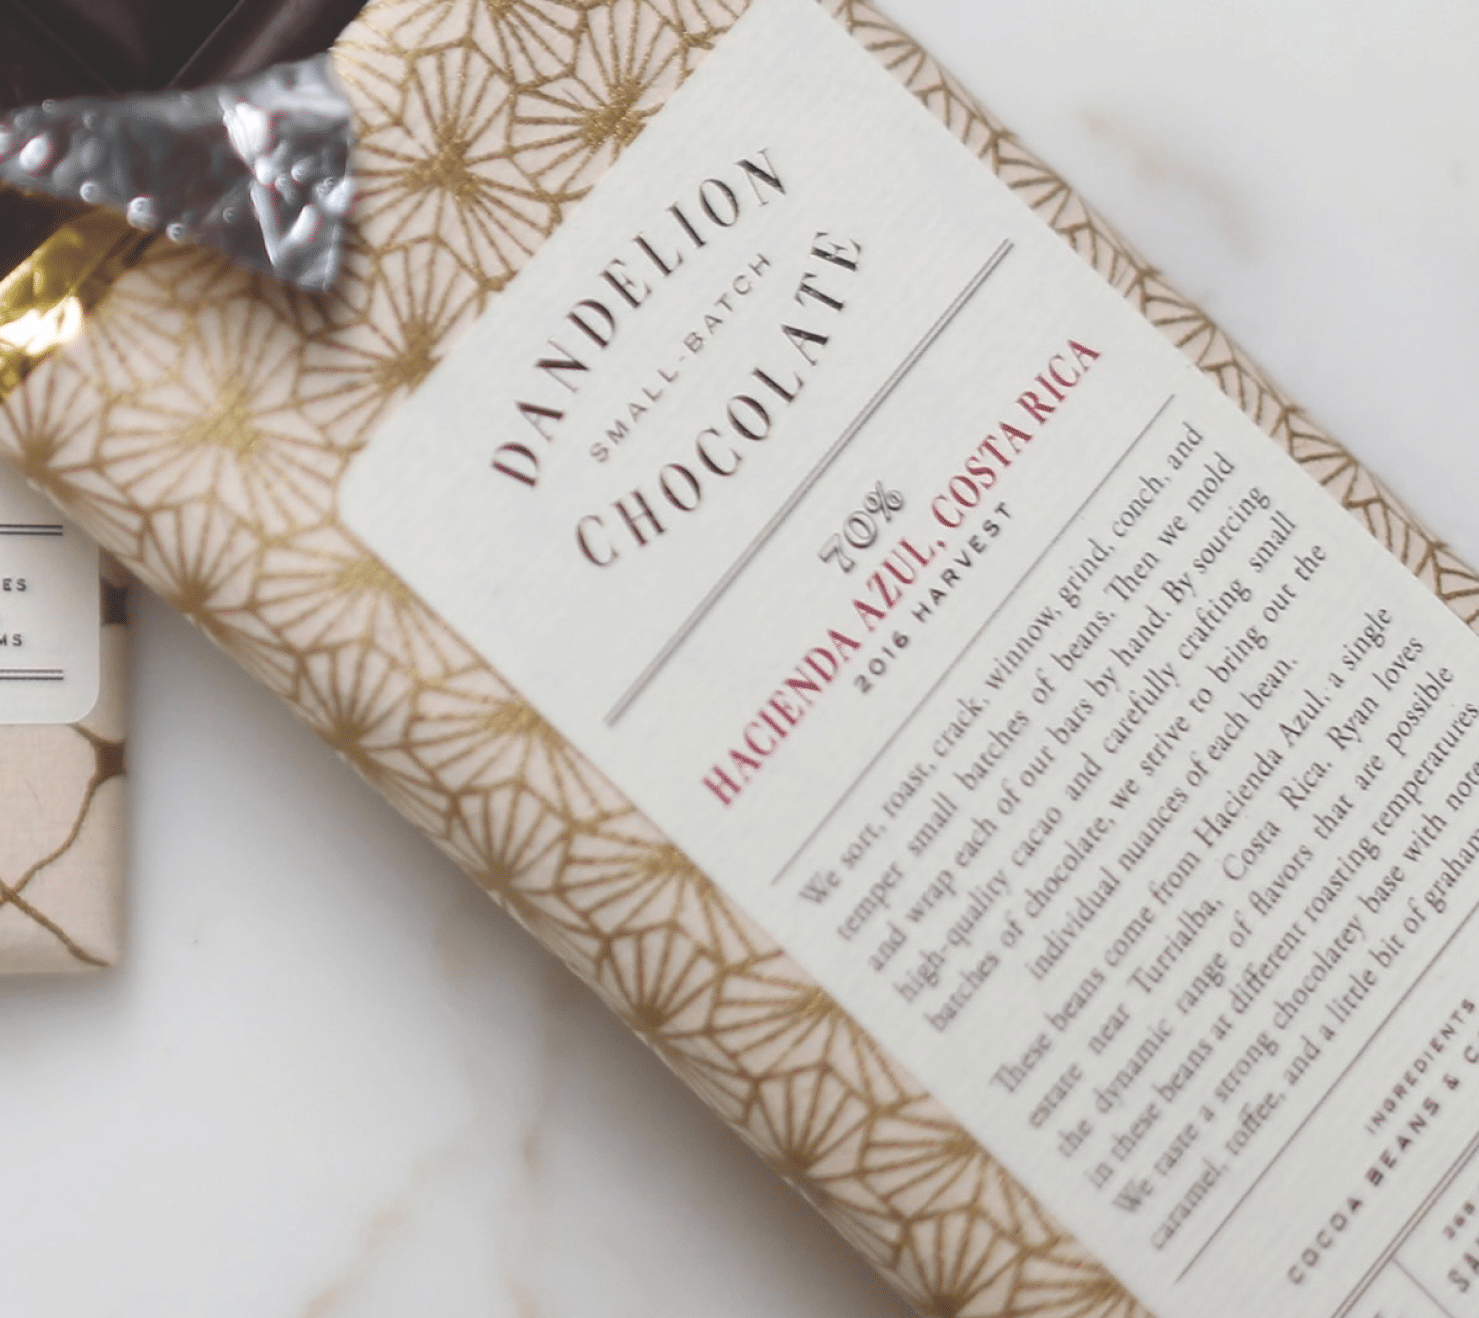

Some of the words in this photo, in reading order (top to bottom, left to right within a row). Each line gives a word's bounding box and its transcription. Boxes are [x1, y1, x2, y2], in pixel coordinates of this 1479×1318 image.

[490, 147, 787, 488] DANDELION
[574, 229, 864, 569] CHOCOLATE
[588, 251, 772, 465] SMALL-BATCH
[702, 628, 862, 806] HACIENDA
[852, 538, 947, 632] AZUL,
[931, 421, 1034, 529] COSTA
[1015, 339, 1101, 425] RICA
[817, 480, 905, 575] 70%
[853, 630, 910, 694] 2016
[911, 500, 1011, 623] HARVEST
[984, 605, 1063, 690] winnow,
[1058, 537, 1115, 610] grind,
[1112, 475, 1171, 538] conch,
[1166, 420, 1204, 471] and
[1045, 697, 1094, 745] bars
[1084, 666, 1117, 698] by
[1108, 604, 1172, 668] hand.
[1160, 571, 1194, 605] By
[1192, 486, 1272, 574] sourcing
[1049, 609, 1116, 672] beans.
[1103, 550, 1160, 602] Then
[1156, 514, 1188, 546] we
[1186, 450, 1236, 513] mold
[1102, 661, 1180, 754] carefully
[1178, 578, 1253, 661] crafting
[1248, 508, 1297, 573] small
[1117, 786, 1189, 872] nuances
[1207, 710, 1250, 761] each
[1239, 658, 1298, 711] bean.
[1139, 715, 1190, 777] strive
[1205, 625, 1269, 683] bring
[1262, 582, 1297, 623] out
[1293, 544, 1327, 582] the
[1192, 748, 1284, 848] Hacienda
[1341, 607, 1392, 671] single
[1222, 819, 1282, 881] Costa
[1325, 695, 1380, 751] Ryan
[1371, 636, 1424, 692] loves
[1247, 843, 1315, 917] flavors
[1312, 793, 1355, 840] that
[1354, 753, 1384, 791] are
[1385, 666, 1454, 757] possible
[1302, 835, 1381, 923] roasting
[1356, 864, 1405, 914] base
[1402, 812, 1448, 862] with
[1325, 968, 1378, 1024] little
